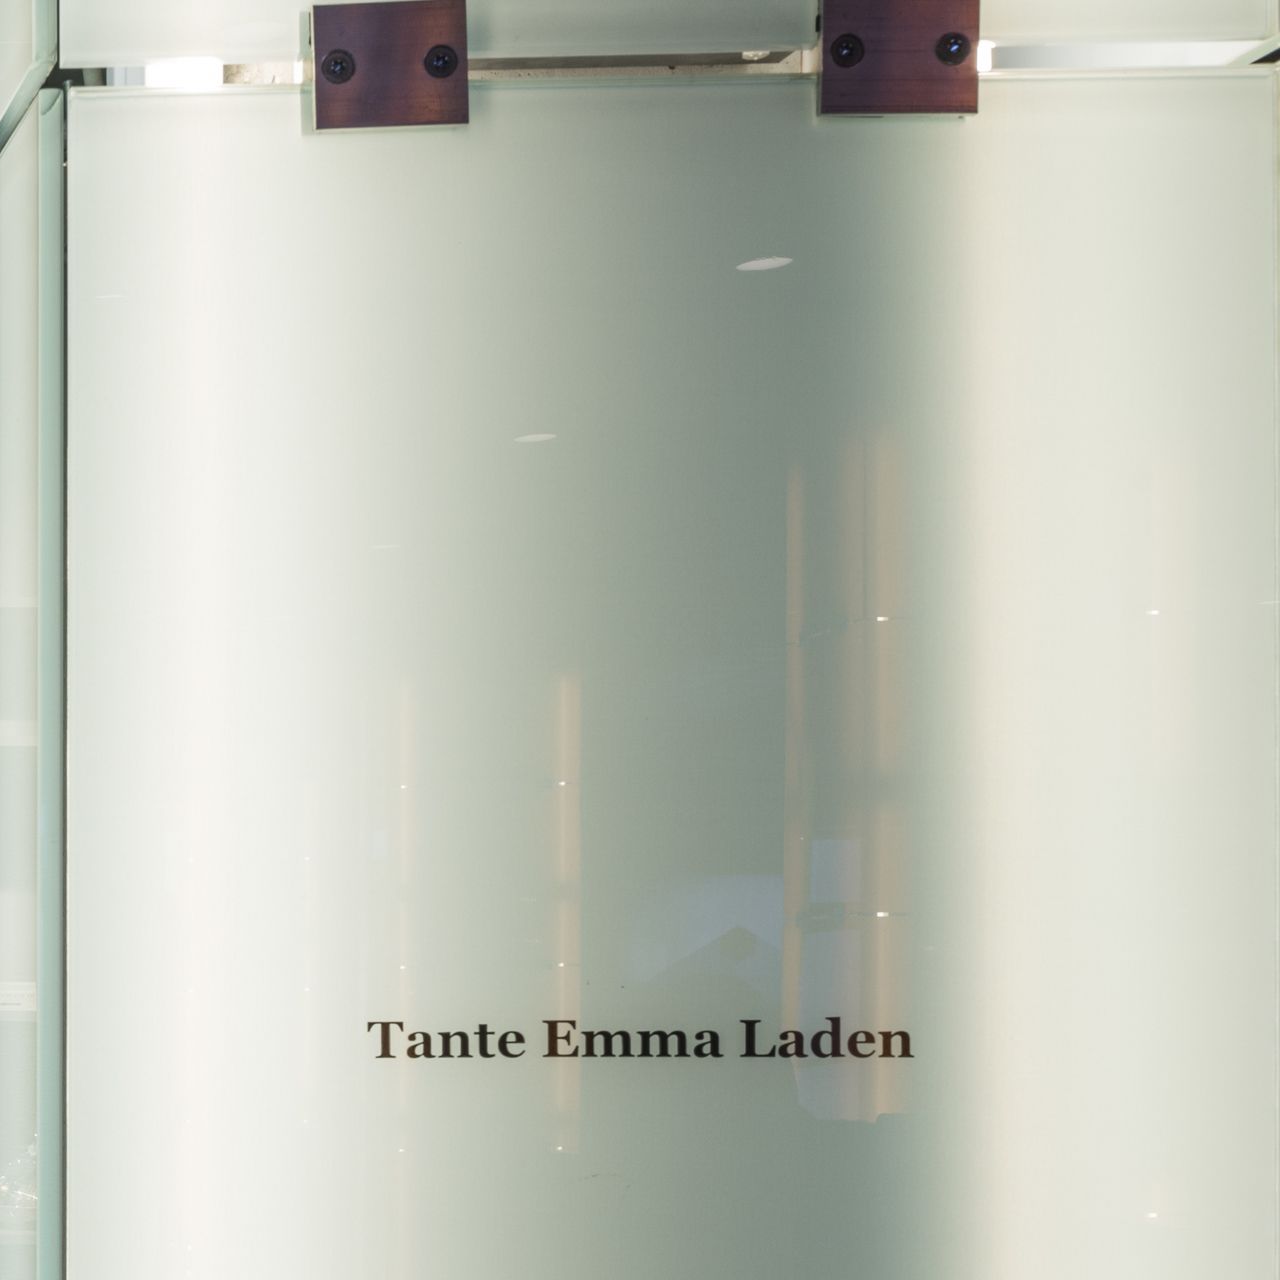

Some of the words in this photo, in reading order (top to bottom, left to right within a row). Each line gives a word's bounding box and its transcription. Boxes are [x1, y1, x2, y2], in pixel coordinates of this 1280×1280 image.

[366, 1021, 525, 1059] Tante
[541, 1019, 725, 1058] Emma
[739, 1016, 915, 1058] Laden
